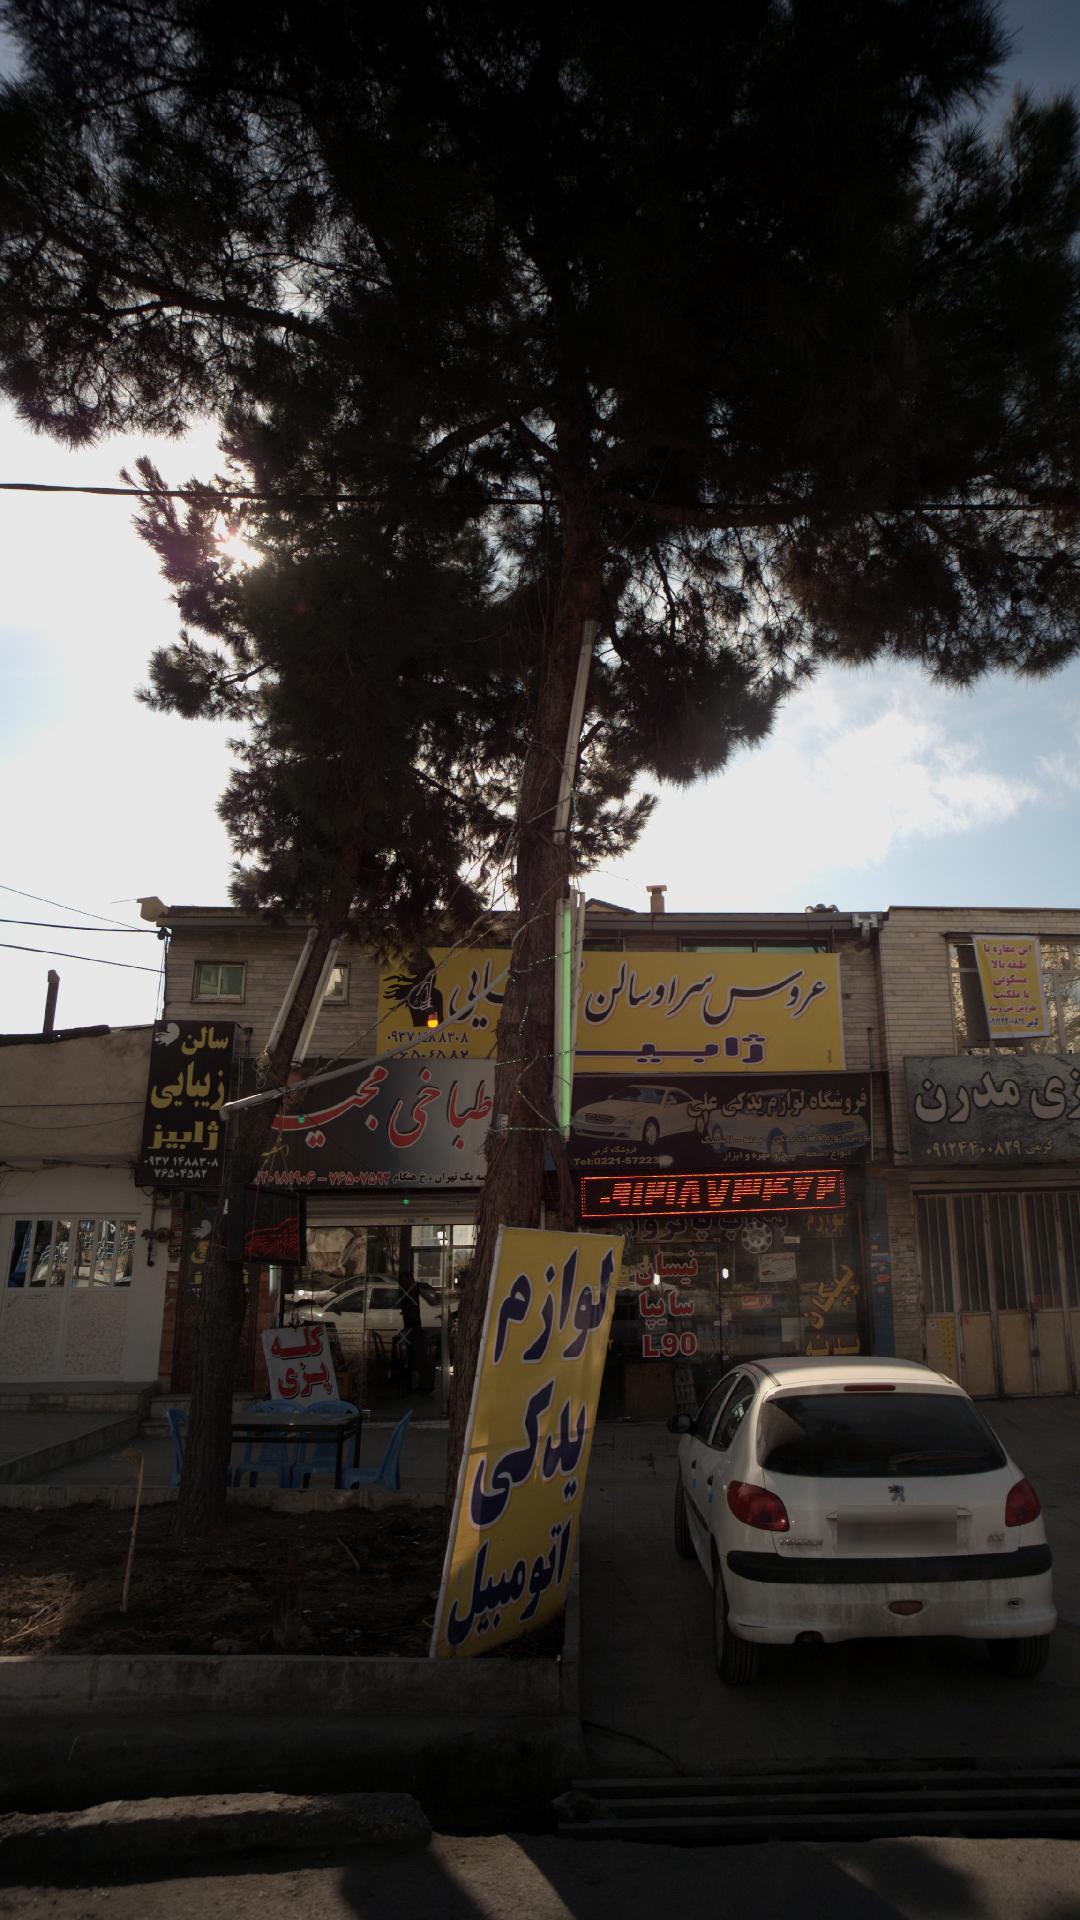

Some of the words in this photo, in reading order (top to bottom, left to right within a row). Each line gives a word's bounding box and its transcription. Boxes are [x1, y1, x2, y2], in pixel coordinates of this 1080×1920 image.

[584, 960, 653, 1024] سالن
[666, 974, 714, 1017] سرا
[702, 968, 828, 1027] عروس
[179, 1024, 229, 1056] سالن
[573, 1033, 767, 1066] ژابی
[150, 1060, 226, 1111] زیبایی
[686, 1090, 719, 1118] علی
[721, 1091, 764, 1117] یدکی
[766, 1088, 806, 1117] لوازم
[809, 1088, 868, 1115] فروشگاه
[914, 1071, 1021, 1124] مدرن
[271, 1065, 390, 1149] مجی
[387, 1066, 495, 1150] طباخی
[144, 1119, 220, 1152] ژابیز
[574, 1156, 661, 1166] Tel:0221-5722
[635, 1249, 699, 1286] نیسان
[492, 1245, 615, 1364] لوازم
[638, 1289, 695, 1330] سایپا
[642, 1331, 698, 1358] L90
[277, 1361, 334, 1400] پزی
[469, 1376, 588, 1529] یدکی
[446, 1518, 573, 1647] اتومبیل
